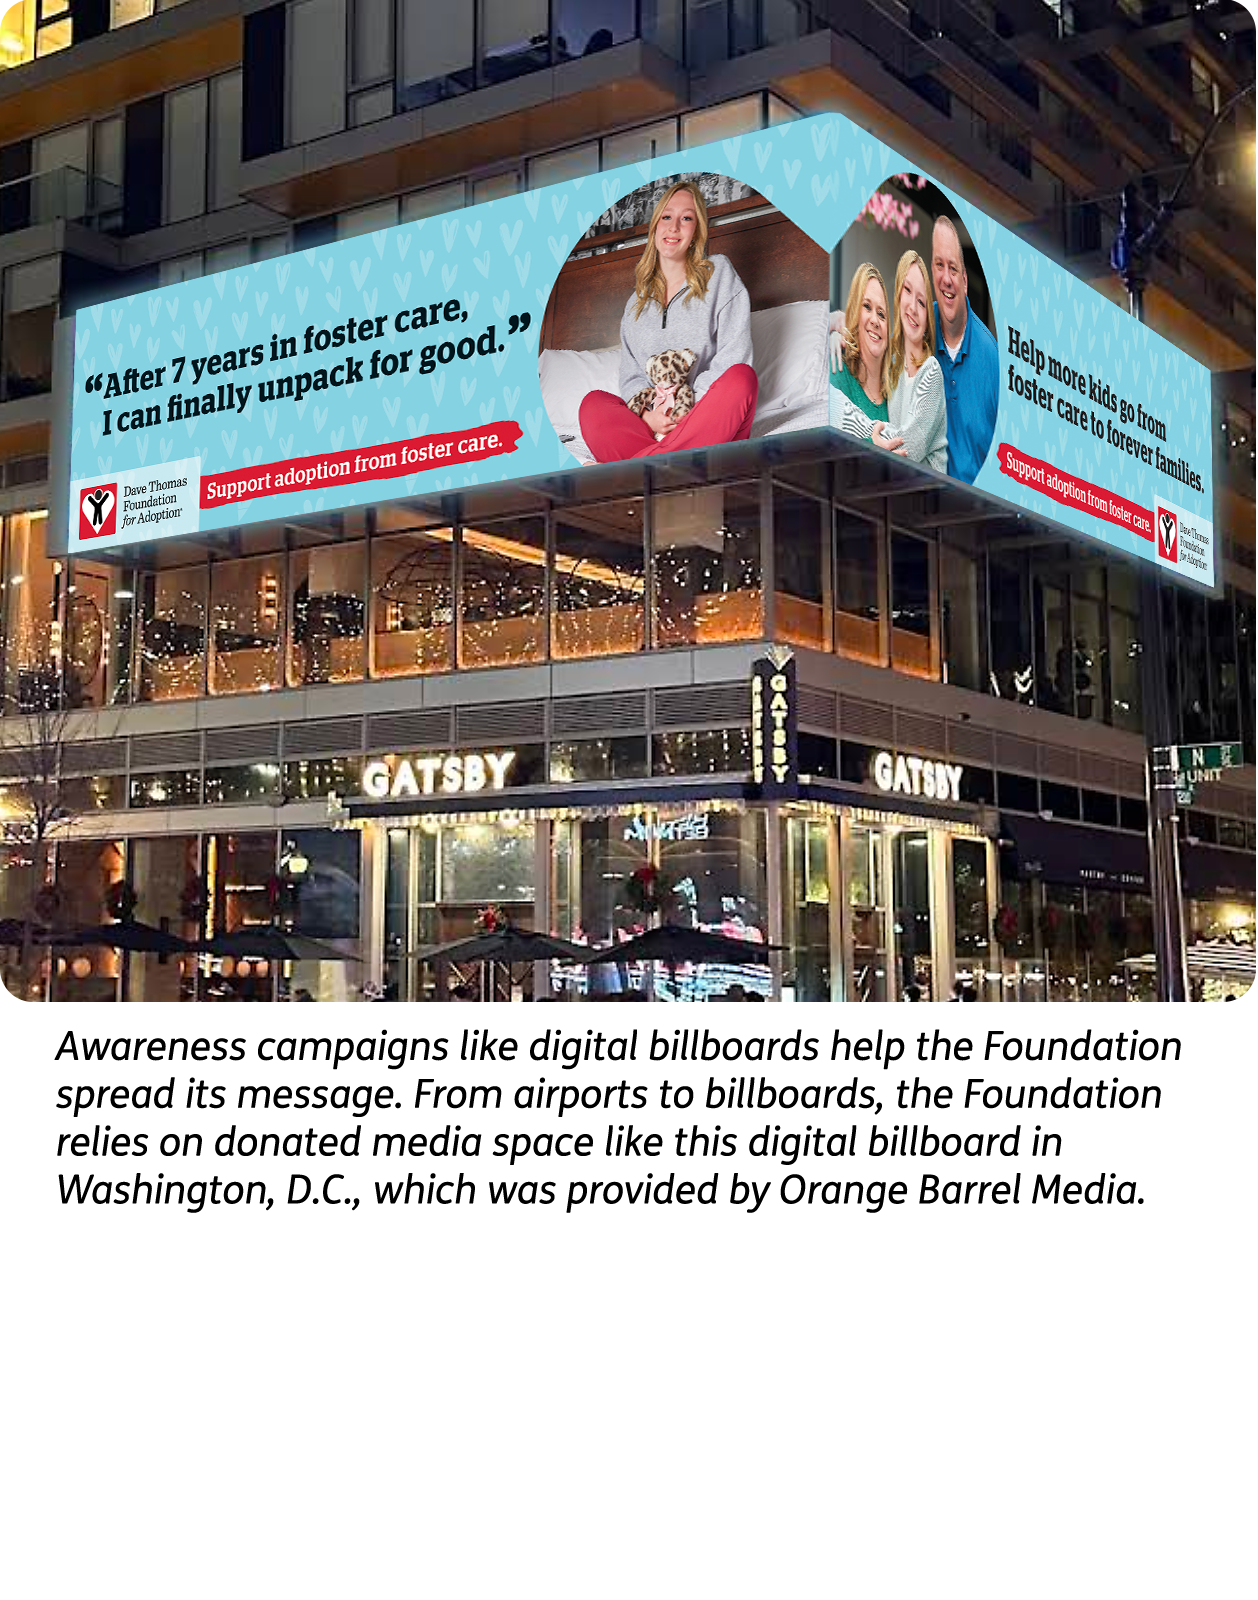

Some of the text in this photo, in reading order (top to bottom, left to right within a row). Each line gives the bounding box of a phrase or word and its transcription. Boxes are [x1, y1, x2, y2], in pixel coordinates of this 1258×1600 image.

[171, 356, 186, 384] 7
[191, 344, 264, 385] years
[269, 333, 298, 362] in
[303, 314, 388, 355] foster
[394, 298, 468, 333] care,
[102, 409, 113, 436] I
[117, 404, 162, 433] can
[166, 382, 253, 423] finally
[257, 356, 364, 402] unpack
[369, 349, 413, 380] for
[1007, 325, 1167, 443] Help more kids go from
[1007, 364, 1205, 494] foster care to forever families.
[123, 477, 188, 498] Dave Thomas
[206, 434, 503, 500] Support adoption from foster care.
[1006, 451, 1152, 534] Support adoption from foster care.
[121, 514, 136, 529] for
[123, 493, 177, 512] Foundation
[770, 674, 789, 784] GATSBY
[362, 752, 516, 797] GATSBY
[874, 751, 963, 802] GATSBY
[1187, 767, 1223, 784] UNIT
